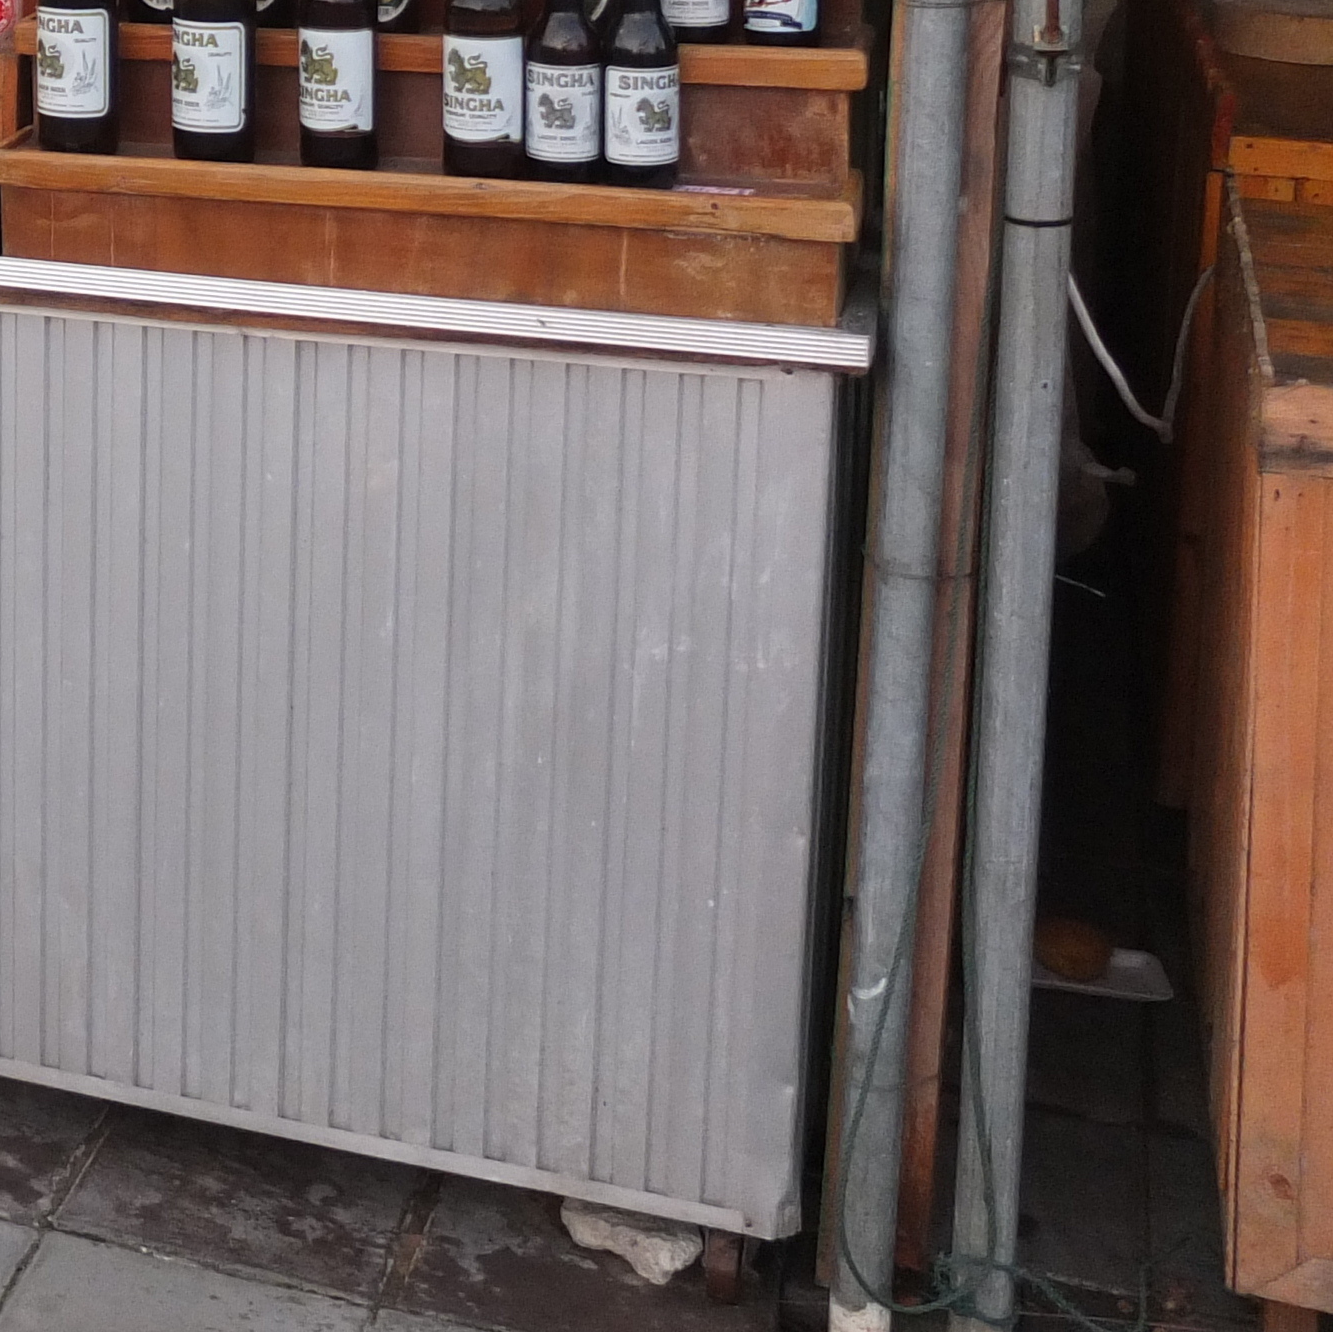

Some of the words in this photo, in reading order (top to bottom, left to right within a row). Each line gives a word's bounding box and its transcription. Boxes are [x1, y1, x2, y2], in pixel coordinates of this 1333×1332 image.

[38, 15, 84, 34] NGHA
[173, 31, 219, 48] NGHA
[528, 72, 595, 88] SINGHA
[618, 73, 679, 90] SINGH
[302, 87, 351, 104] INGHA
[443, 92, 505, 112] SINGHA
